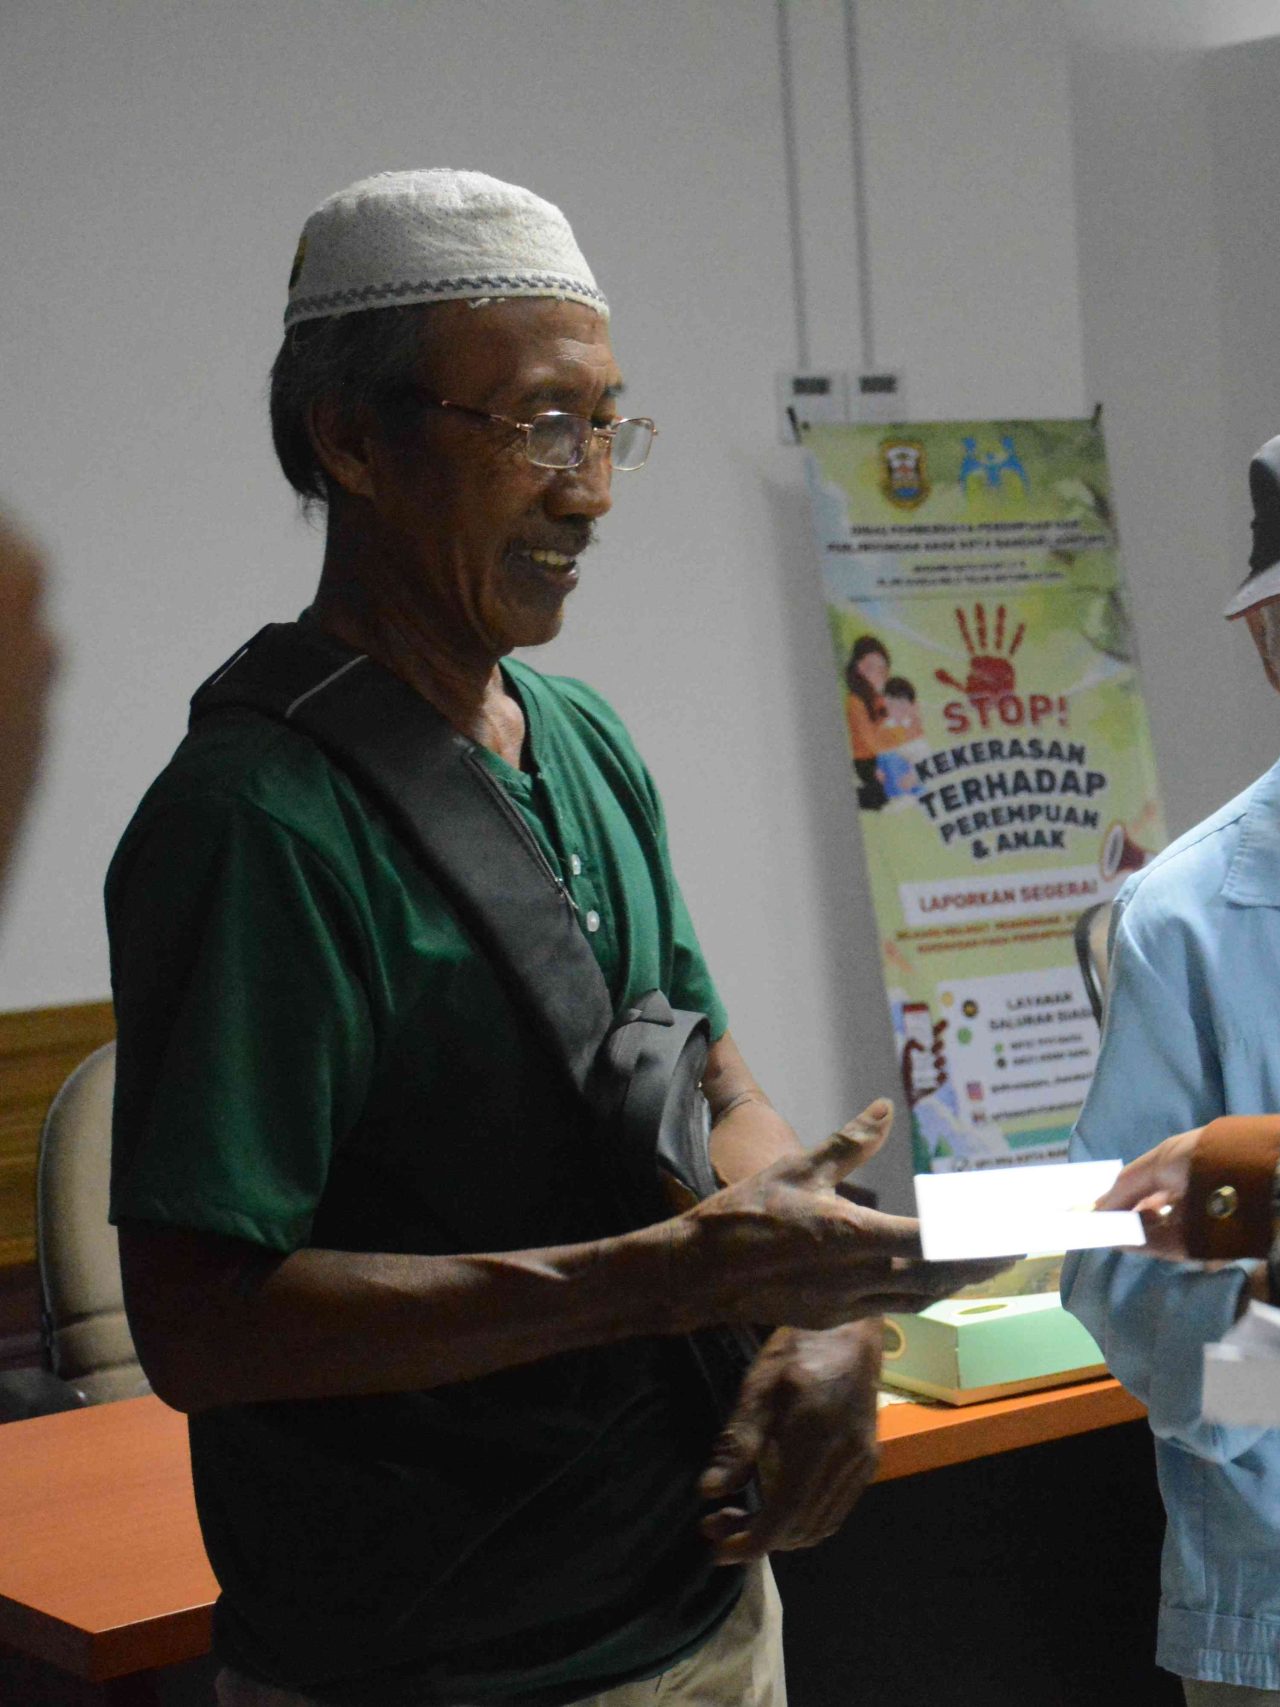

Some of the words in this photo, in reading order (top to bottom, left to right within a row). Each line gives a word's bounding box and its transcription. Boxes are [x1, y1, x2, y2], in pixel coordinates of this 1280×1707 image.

[943, 694, 1068, 734] STOP!
[914, 738, 1086, 782] KEKERASAN
[919, 768, 1106, 819] TERHADAP
[940, 804, 1098, 843] PEREMPUAN
[971, 839, 990, 859] &
[997, 829, 1065, 852] ANAK
[920, 887, 1016, 913] LAPORKAN
